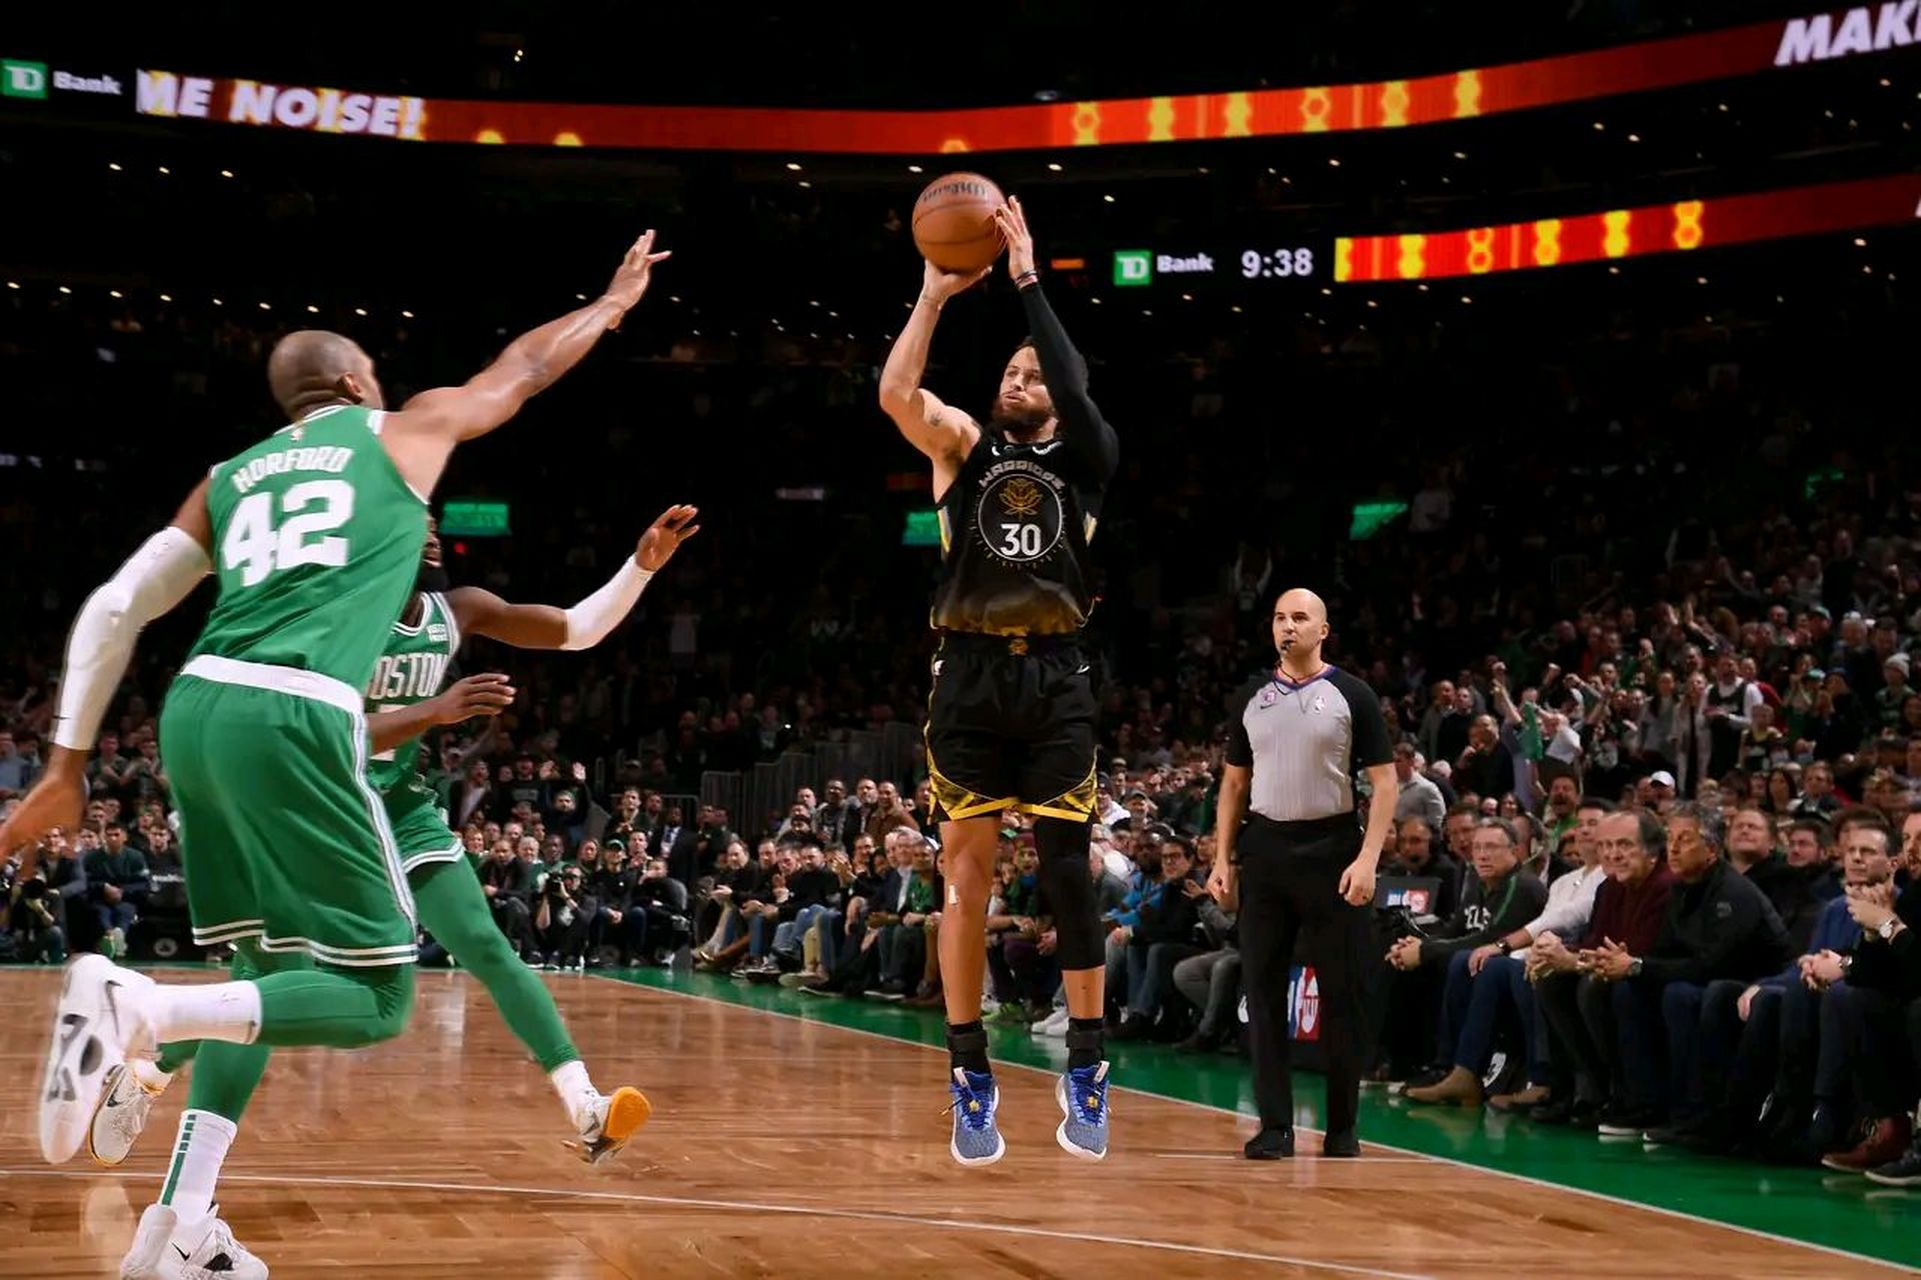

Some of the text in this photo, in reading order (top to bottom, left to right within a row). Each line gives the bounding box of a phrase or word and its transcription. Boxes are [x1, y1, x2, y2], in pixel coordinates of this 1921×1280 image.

[1774, 0, 1921, 66] MAK
[4, 65, 122, 95] TD Bank
[136, 68, 424, 141] ME NOISE!
[1117, 252, 1214, 279] TD Bank
[1241, 248, 1314, 278] 9:38
[231, 445, 354, 494] HORFORD
[979, 460, 1066, 491] WARRIORS
[222, 479, 355, 587] 42
[1000, 523, 1041, 556] 30
[367, 653, 450, 700] OSTON
